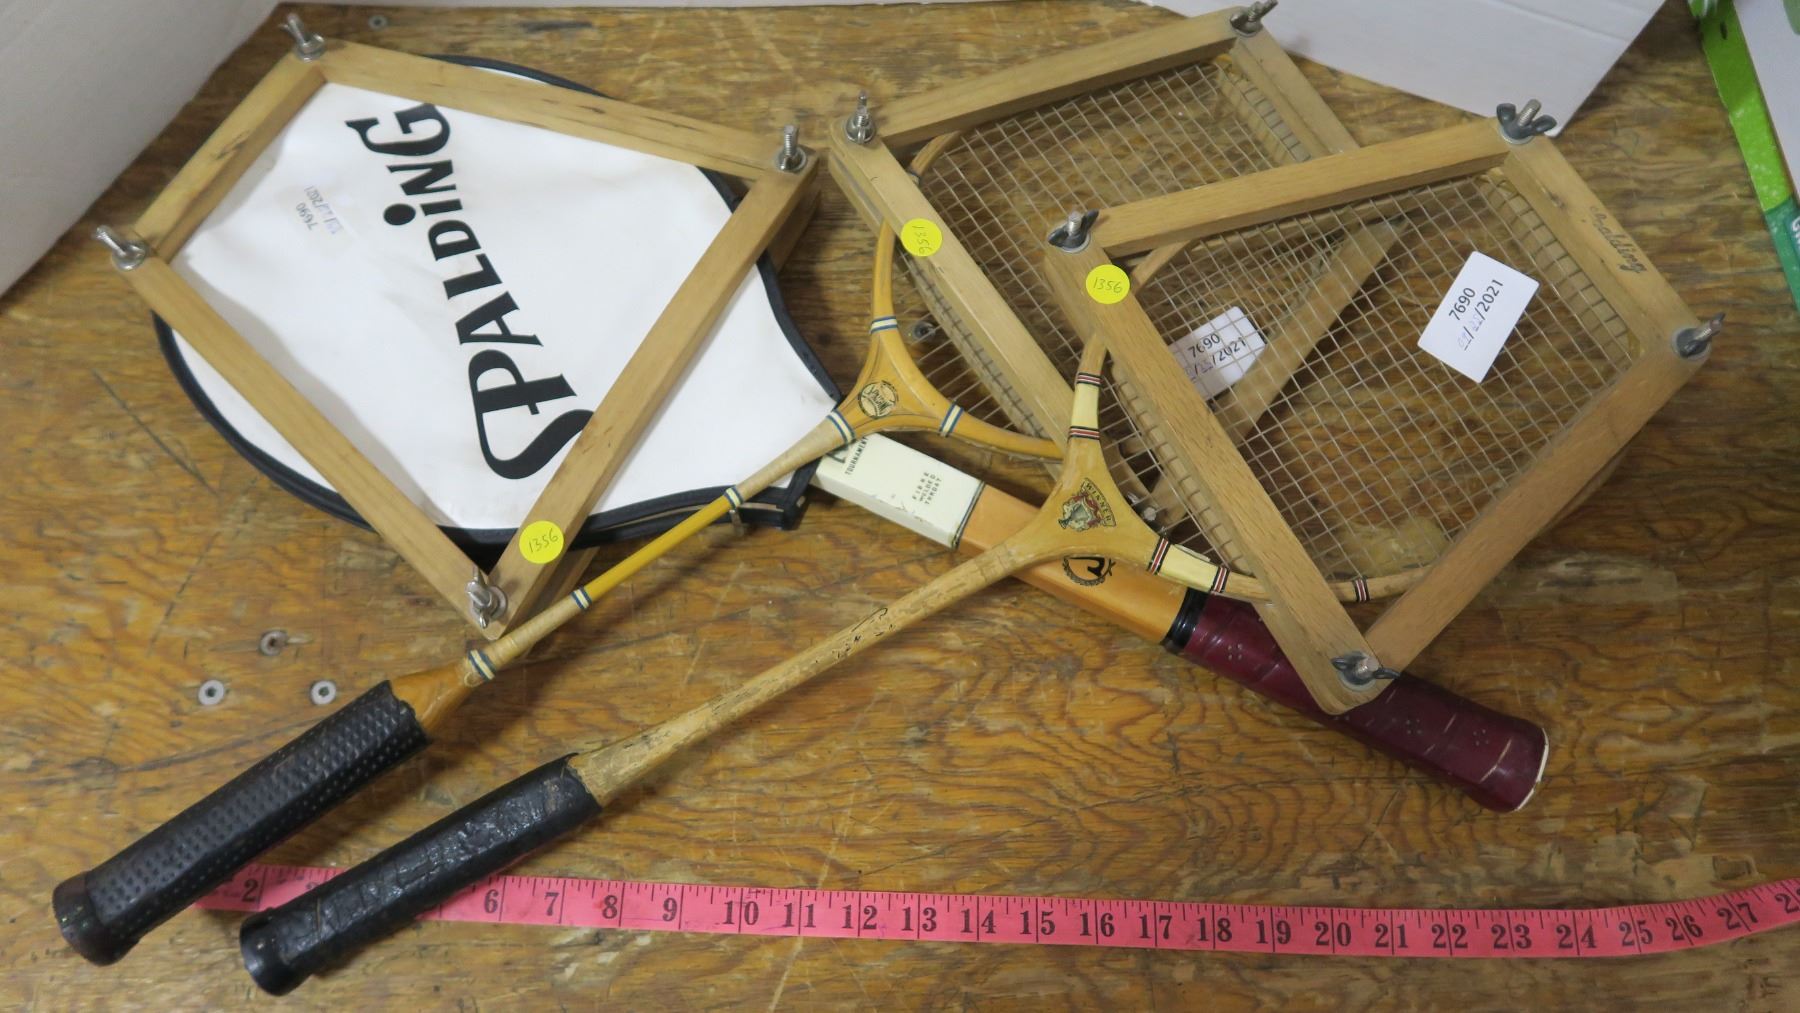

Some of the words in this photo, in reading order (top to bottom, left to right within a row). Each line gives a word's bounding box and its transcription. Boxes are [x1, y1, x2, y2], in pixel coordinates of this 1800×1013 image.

[296, 202, 319, 231] 7690
[911, 225, 933, 255] 1356
[1093, 276, 1123, 294] 1356
[1448, 287, 1476, 321] 7690
[1187, 332, 1220, 358] 7690
[845, 436, 869, 476] TOURNAMENT
[1085, 482, 1112, 521] WINNER
[528, 527, 560, 553] 1356
[241, 878, 259, 903] 2
[483, 889, 500, 915] 6
[544, 891, 560, 916] 7
[602, 895, 618, 921] 8
[662, 897, 678, 923] 9
[722, 900, 760, 926] 10
[784, 902, 816, 928] 11
[842, 903, 878, 931] 12
[900, 905, 938, 933] 13
[960, 907, 997, 935] 14
[1020, 908, 1056, 937] 15
[1079, 910, 1115, 938] 16
[1138, 912, 1173, 940] 17
[1197, 914, 1233, 942] 18
[1255, 918, 1292, 945] 19
[1314, 920, 1352, 947] 20
[1374, 922, 1409, 949] 21
[1432, 922, 1470, 949] 22
[1491, 923, 1533, 950] 23
[1555, 922, 1598, 949] 24
[1618, 919, 1654, 947] 25
[1666, 913, 1704, 942] 26
[1716, 902, 1759, 932] 27
[1774, 887, 1800, 915] 2
